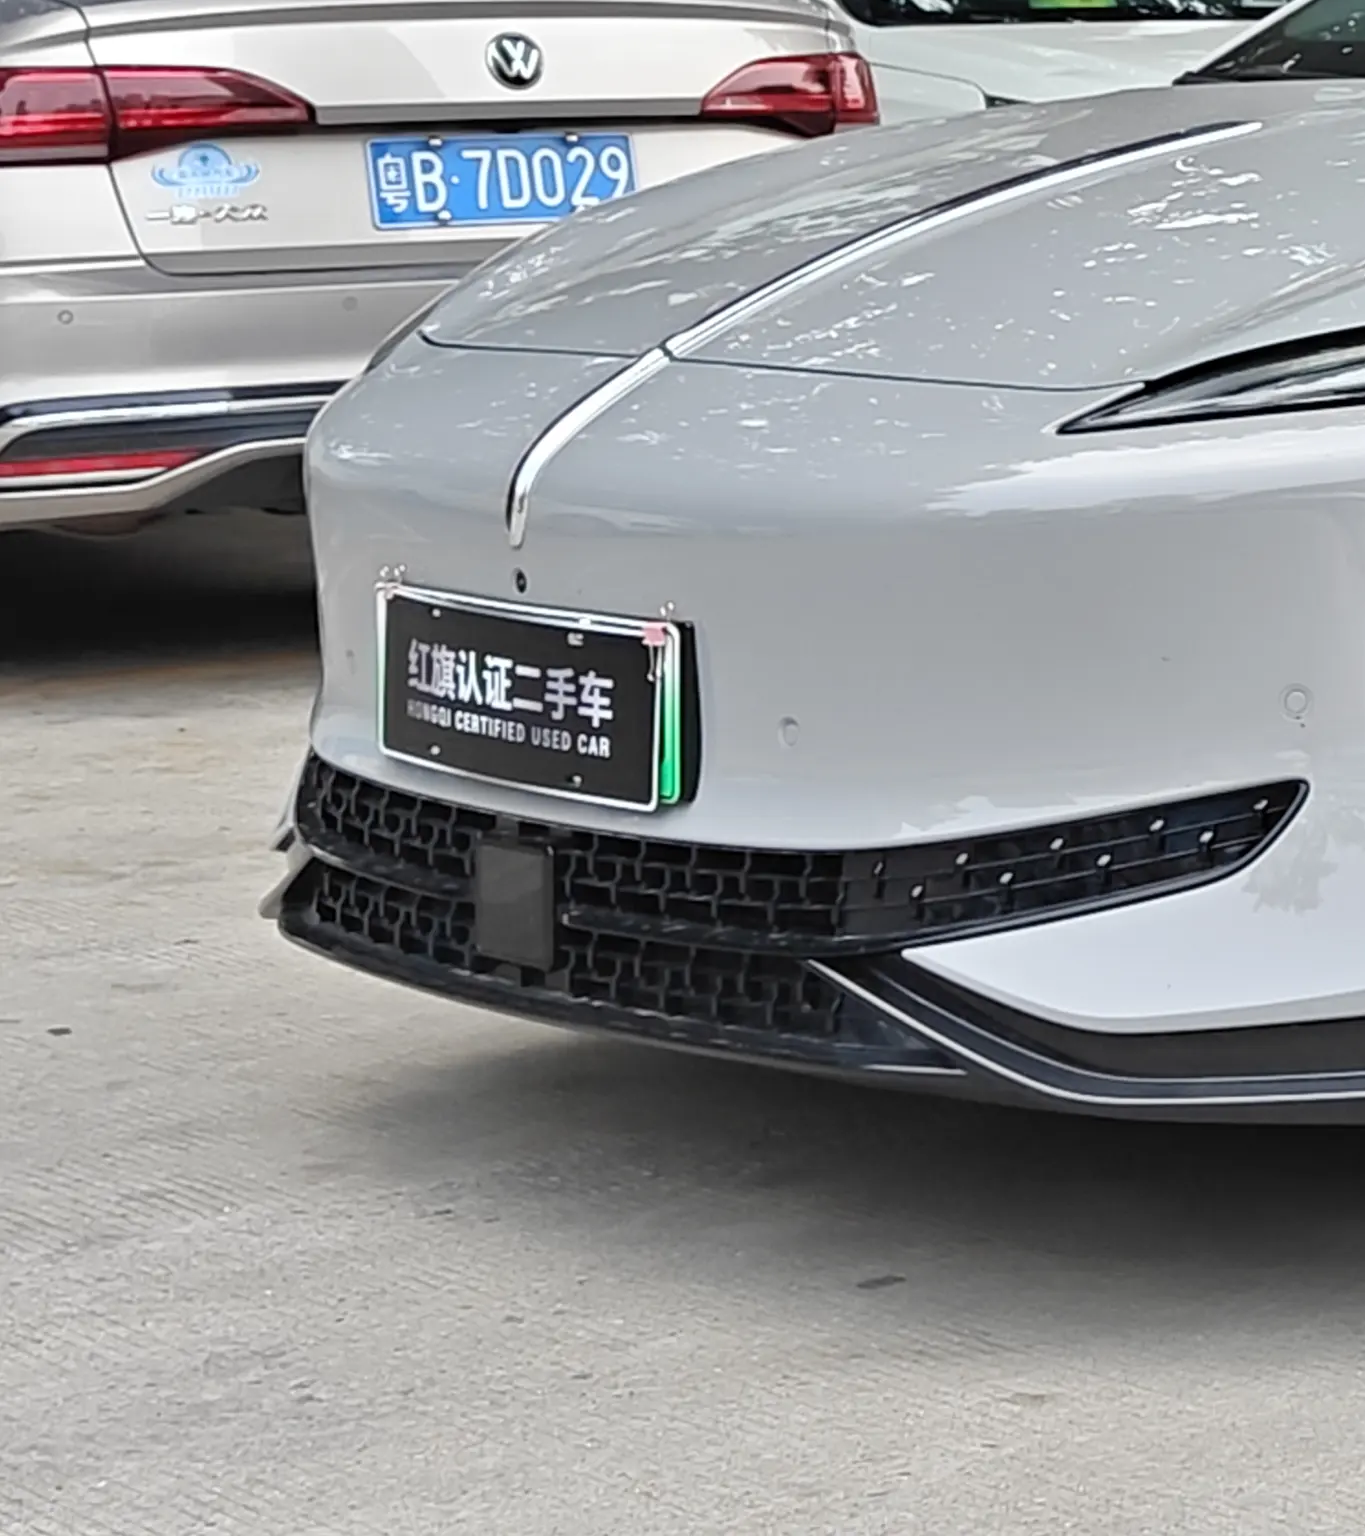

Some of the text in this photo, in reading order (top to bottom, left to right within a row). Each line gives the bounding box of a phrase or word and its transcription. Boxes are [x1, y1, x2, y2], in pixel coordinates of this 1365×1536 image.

[407, 638, 614, 729] 红旗认证二手车
[455, 710, 526, 744] CERTIFIED
[531, 725, 572, 751] USED
[577, 733, 611, 758] CAR
